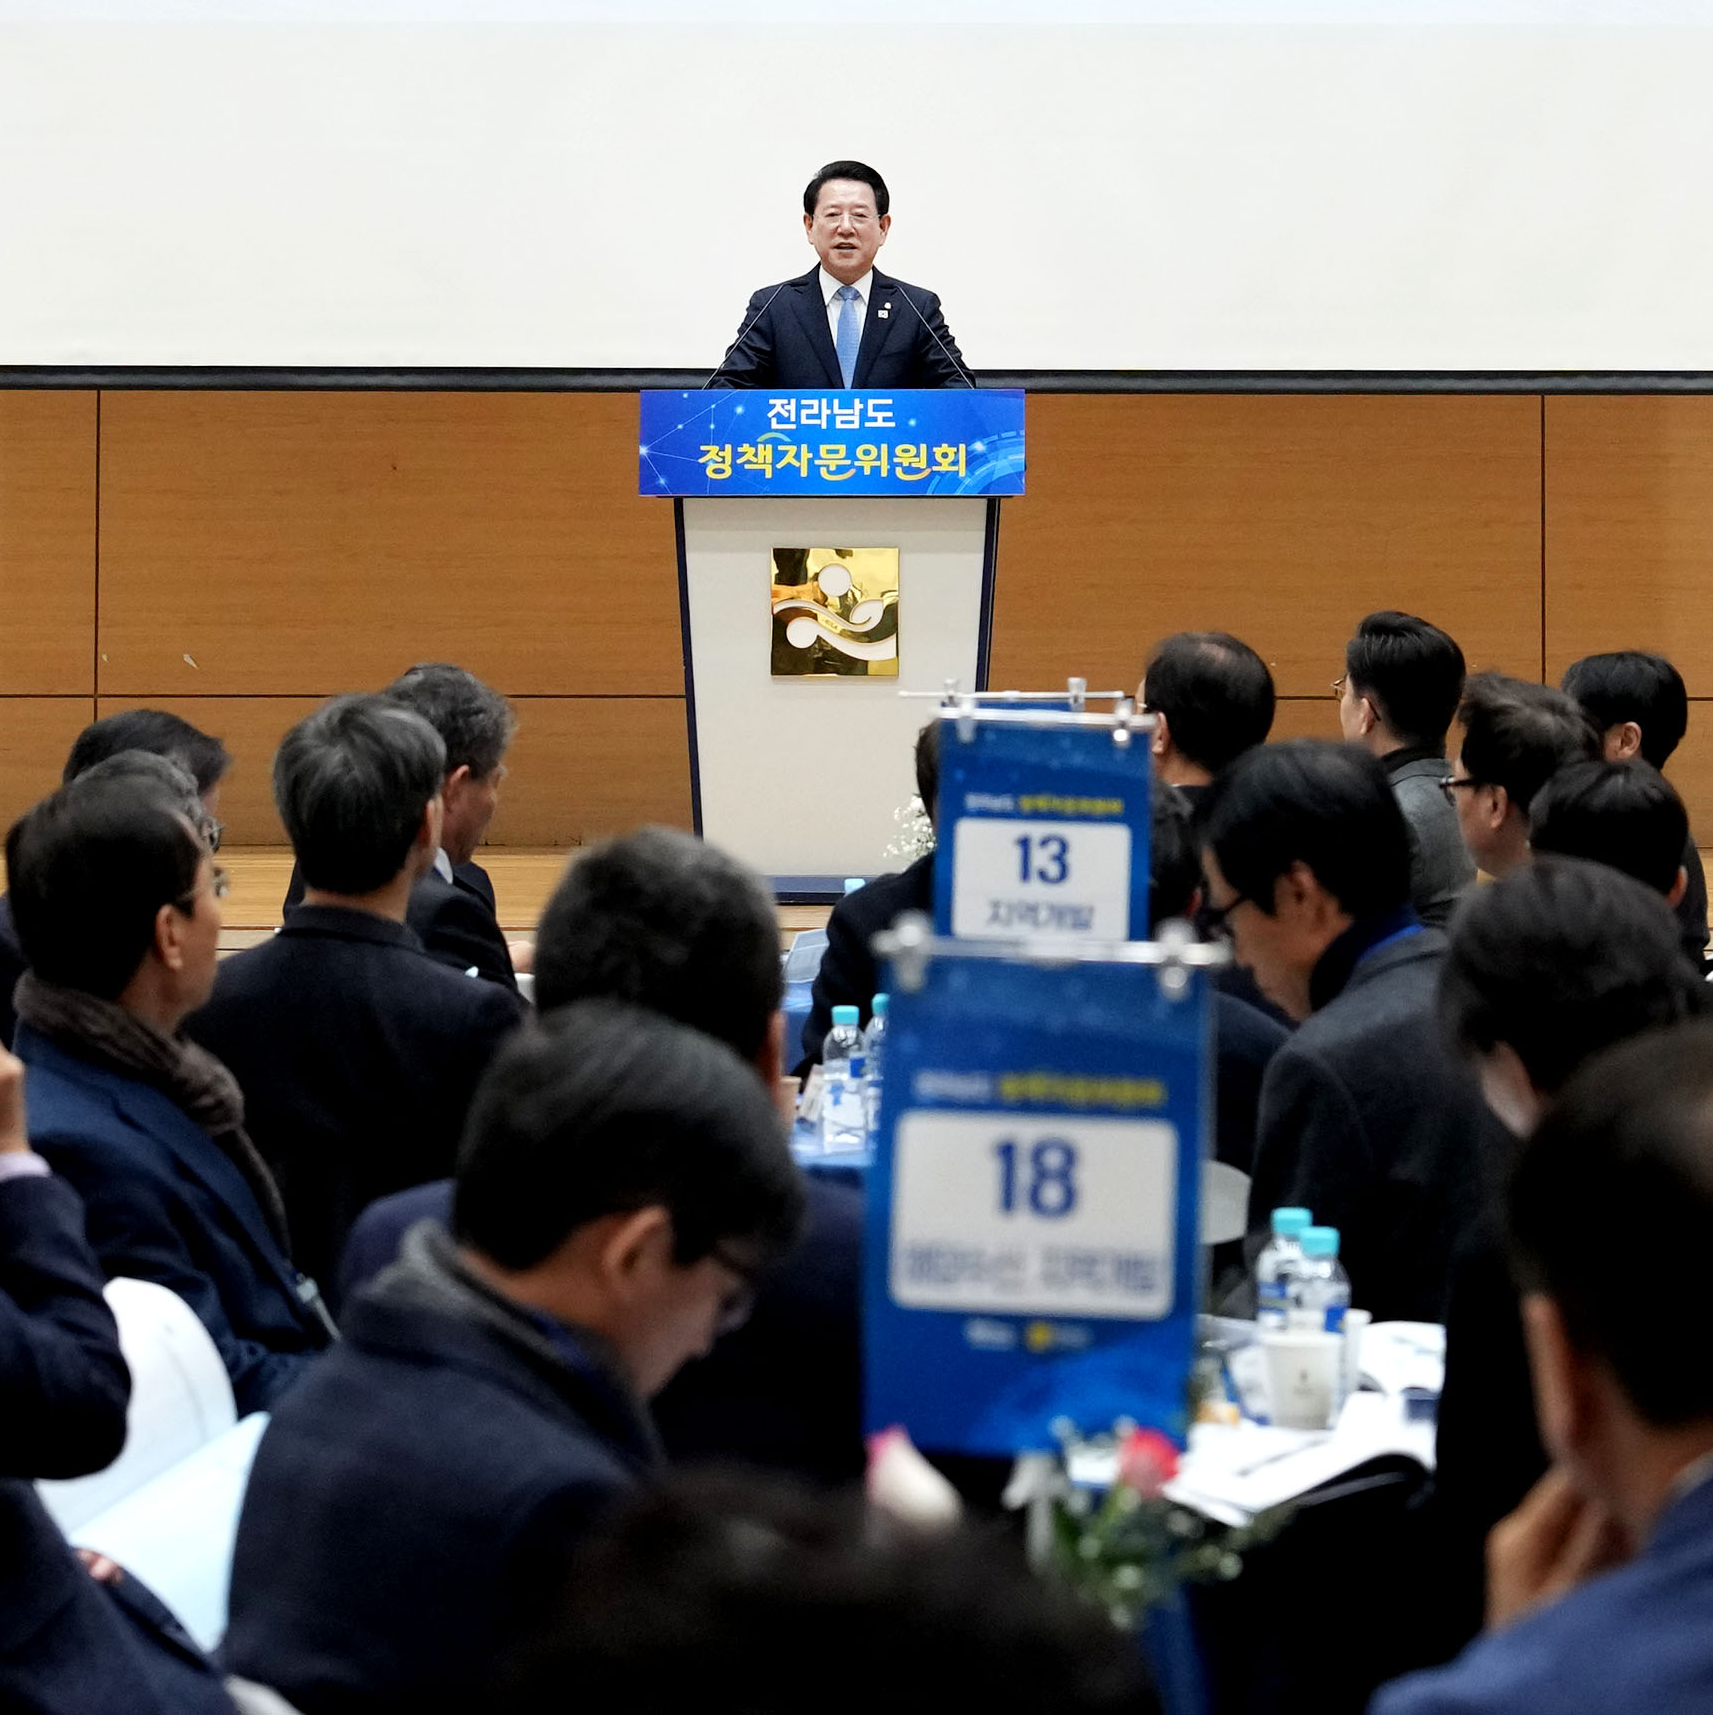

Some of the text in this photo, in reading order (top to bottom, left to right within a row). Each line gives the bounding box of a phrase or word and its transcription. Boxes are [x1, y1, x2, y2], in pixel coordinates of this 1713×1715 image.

[767, 398, 896, 430] 전라남도
[698, 442, 967, 481] 정책자문위원회
[1016, 834, 1070, 885] 13
[994, 1138, 1079, 1219] 18
